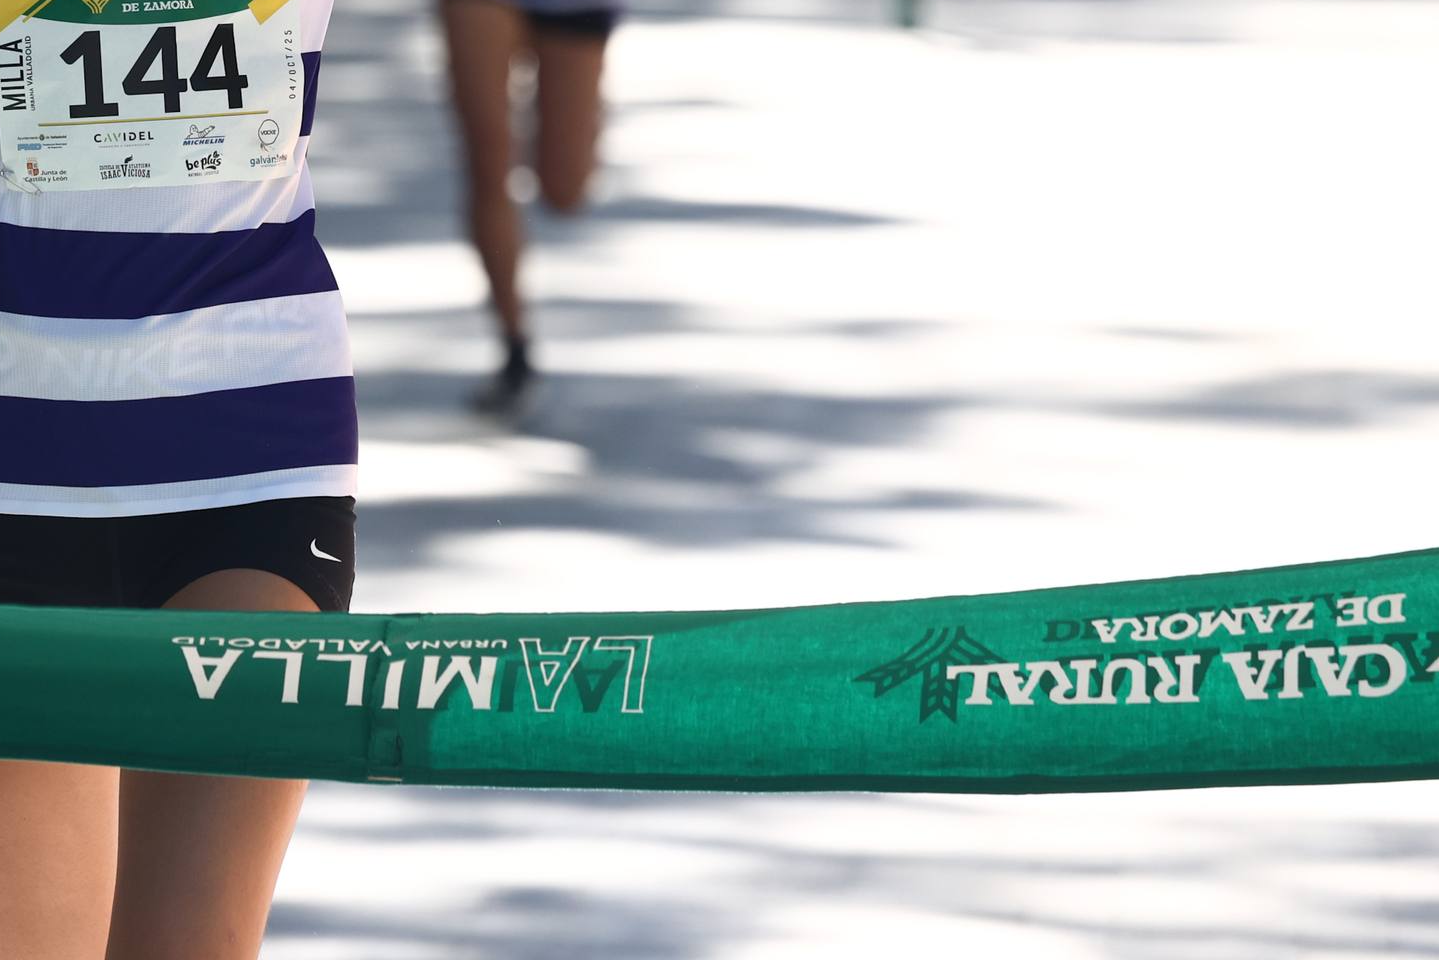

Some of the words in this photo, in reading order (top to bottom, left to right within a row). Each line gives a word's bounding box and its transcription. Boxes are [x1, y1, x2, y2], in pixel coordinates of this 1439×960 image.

[122, 3, 139, 13] DE
[144, 0, 194, 11] ZAMORA
[0, 39, 27, 111] MILLA
[25, 35, 33, 86] VALLADOLID
[60, 23, 249, 119] 144
[93, 131, 154, 143] CAVIDEL
[182, 138, 225, 146] MICHELIN
[185, 159, 199, 171] be
[200, 153, 222, 170] plus
[1091, 602, 1314, 643] ZAMORA
[1336, 592, 1407, 627] DE
[171, 636, 392, 656] VALLADOLID
[405, 639, 507, 650] URBANA
[946, 654, 1200, 706] RURAL
[1222, 643, 1407, 700] CAJA
